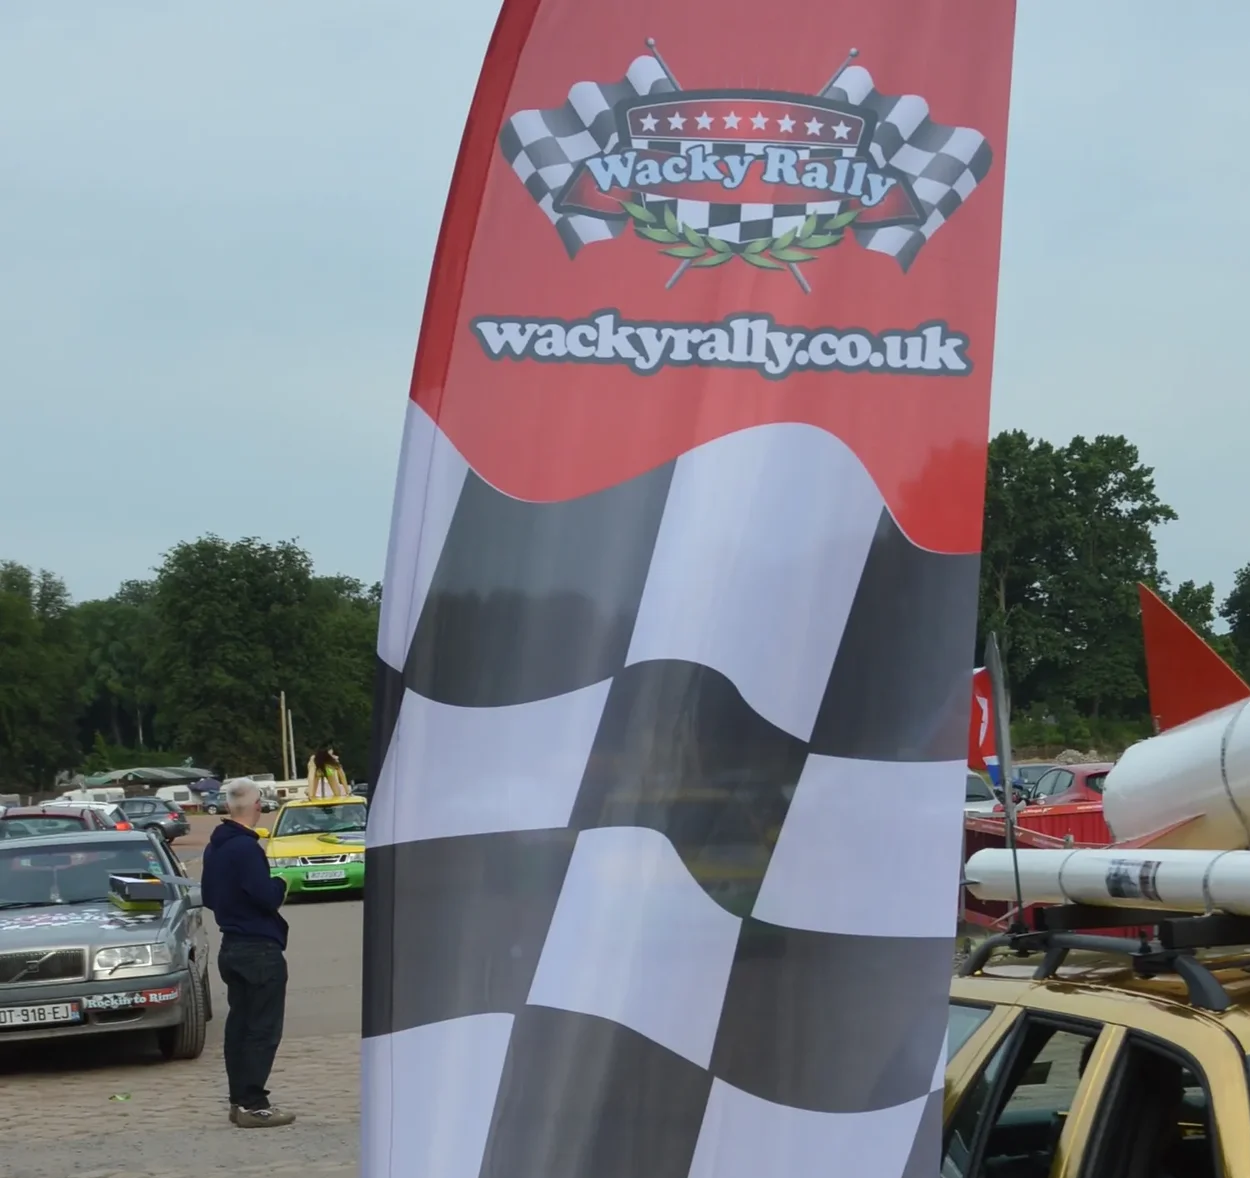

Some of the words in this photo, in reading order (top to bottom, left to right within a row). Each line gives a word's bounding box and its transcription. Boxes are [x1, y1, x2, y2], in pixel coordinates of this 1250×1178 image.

[586, 146, 753, 192] Wacky
[764, 146, 897, 206] Rally
[474, 312, 968, 376] wackyrally.co.uk
[134, 996, 147, 1004] to
